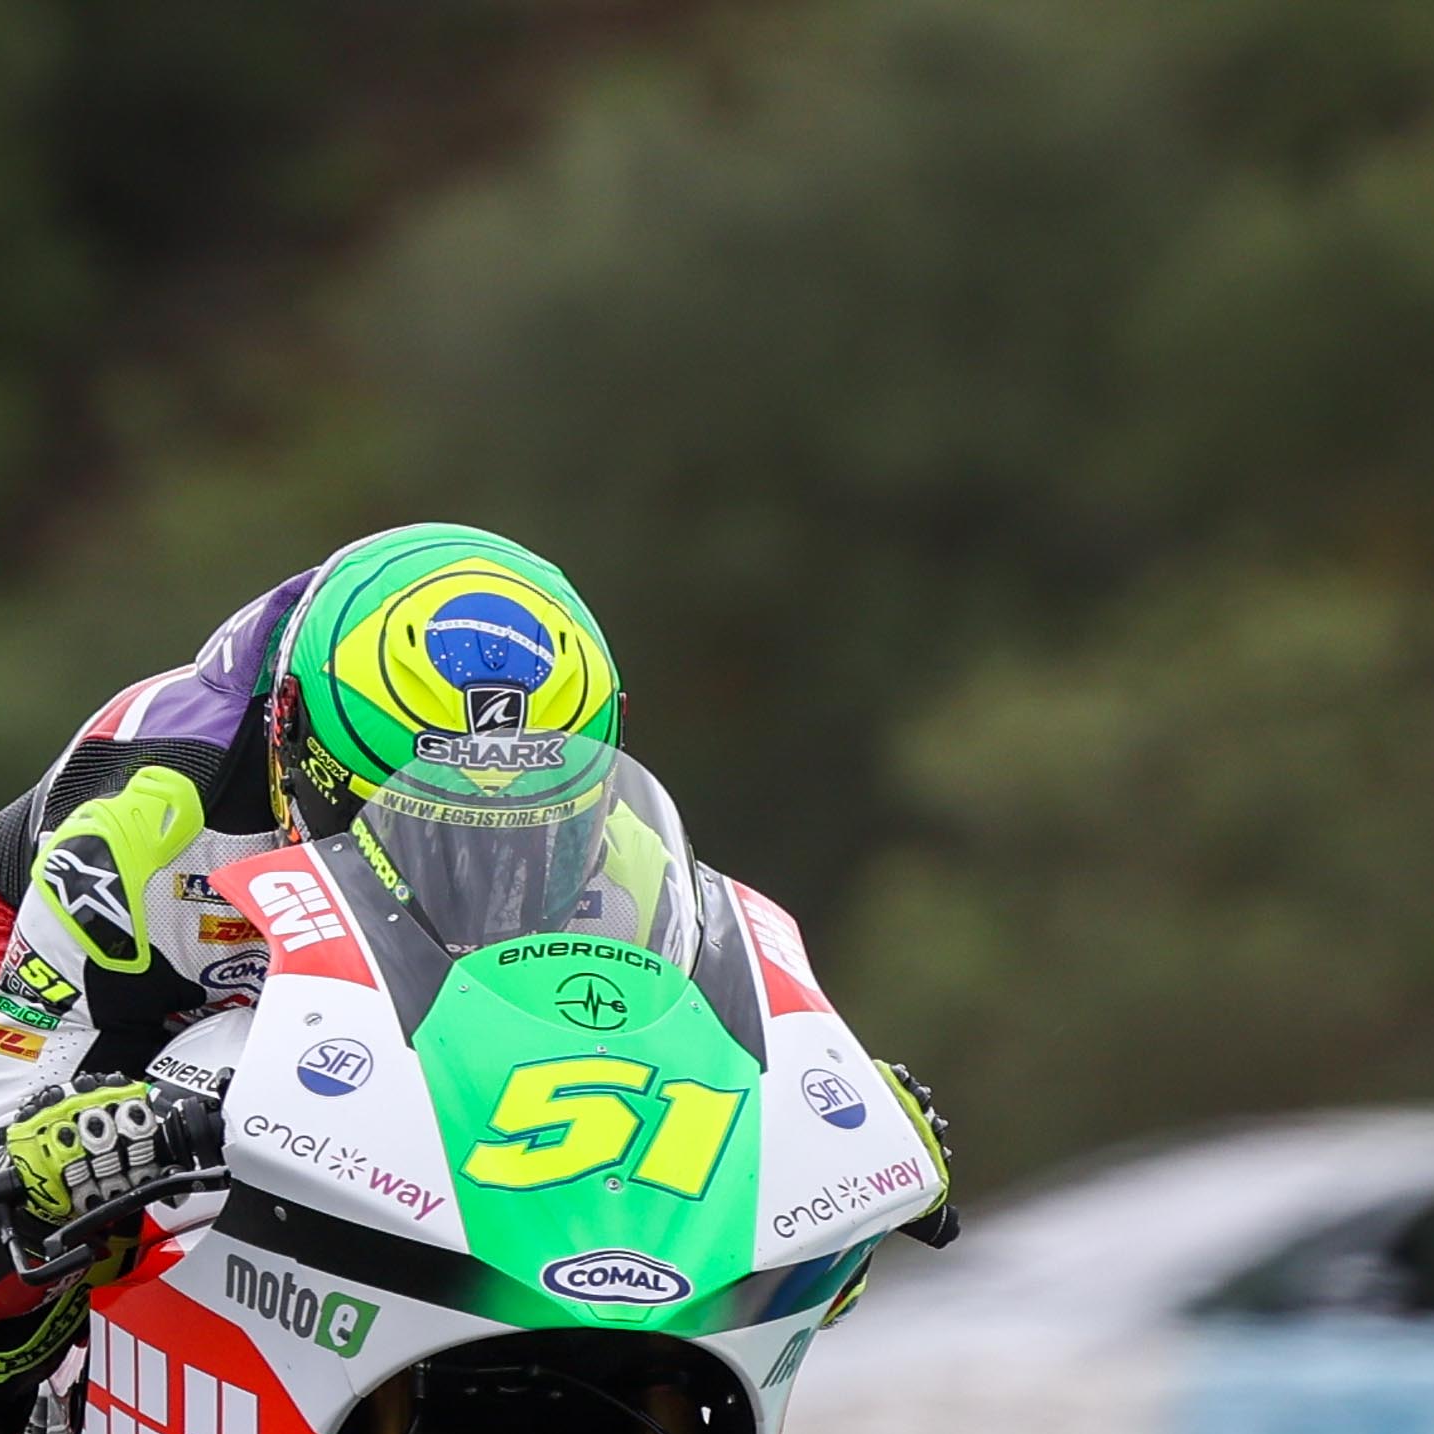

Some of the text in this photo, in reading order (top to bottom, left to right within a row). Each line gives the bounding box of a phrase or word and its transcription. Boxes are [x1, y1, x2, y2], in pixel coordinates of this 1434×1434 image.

[307, 737, 349, 781] SHARK
[418, 733, 564, 767] SHARK
[248, 872, 347, 953] GIVI
[218, 962, 267, 982] COM
[306, 1045, 366, 1081] SIFI
[807, 1077, 854, 1111] SIFI
[458, 1053, 751, 1202] 51
[244, 1115, 445, 1221] enel way
[773, 1158, 924, 1238] enel way
[567, 1267, 668, 1292] COMAL
